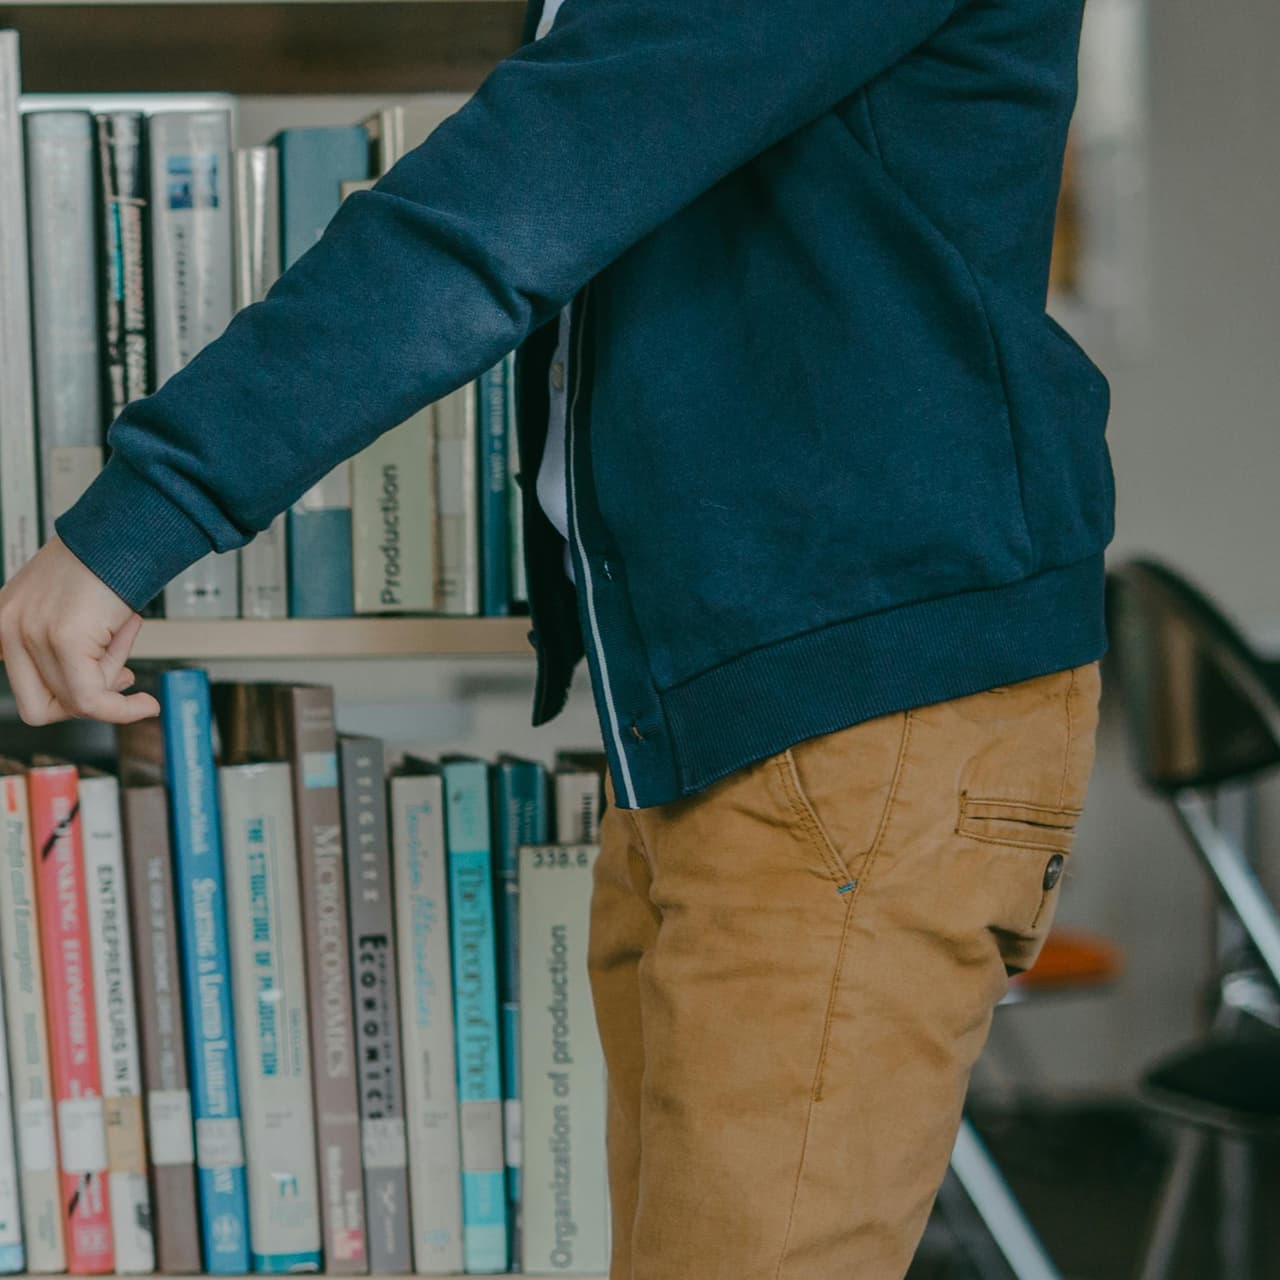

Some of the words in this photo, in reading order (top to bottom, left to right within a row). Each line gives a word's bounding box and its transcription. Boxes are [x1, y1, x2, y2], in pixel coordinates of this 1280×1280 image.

[379, 463, 402, 604] Production
[49, 796, 81, 931] RETHINKING
[244, 816, 266, 844] THE
[356, 756, 380, 904] STIGLITZ
[191, 877, 219, 958] STARTING
[247, 852, 272, 943] STRUCTURE
[457, 864, 489, 907] The
[96, 863, 129, 1053] ENTREPRENEURS
[311, 824, 350, 1079] MICROECONOMICS
[456, 911, 489, 1000] Theory
[546, 925, 576, 1065] production
[61, 937, 88, 1065] ECONOMICS
[200, 972, 226, 1040] LIMITED
[464, 1003, 491, 1030] of
[112, 1057, 134, 1083] IN
[203, 1040, 229, 1117] LIABILITY
[465, 1032, 493, 1100] Price
[546, 1072, 569, 1098] of
[547, 1103, 579, 1269] Organization
